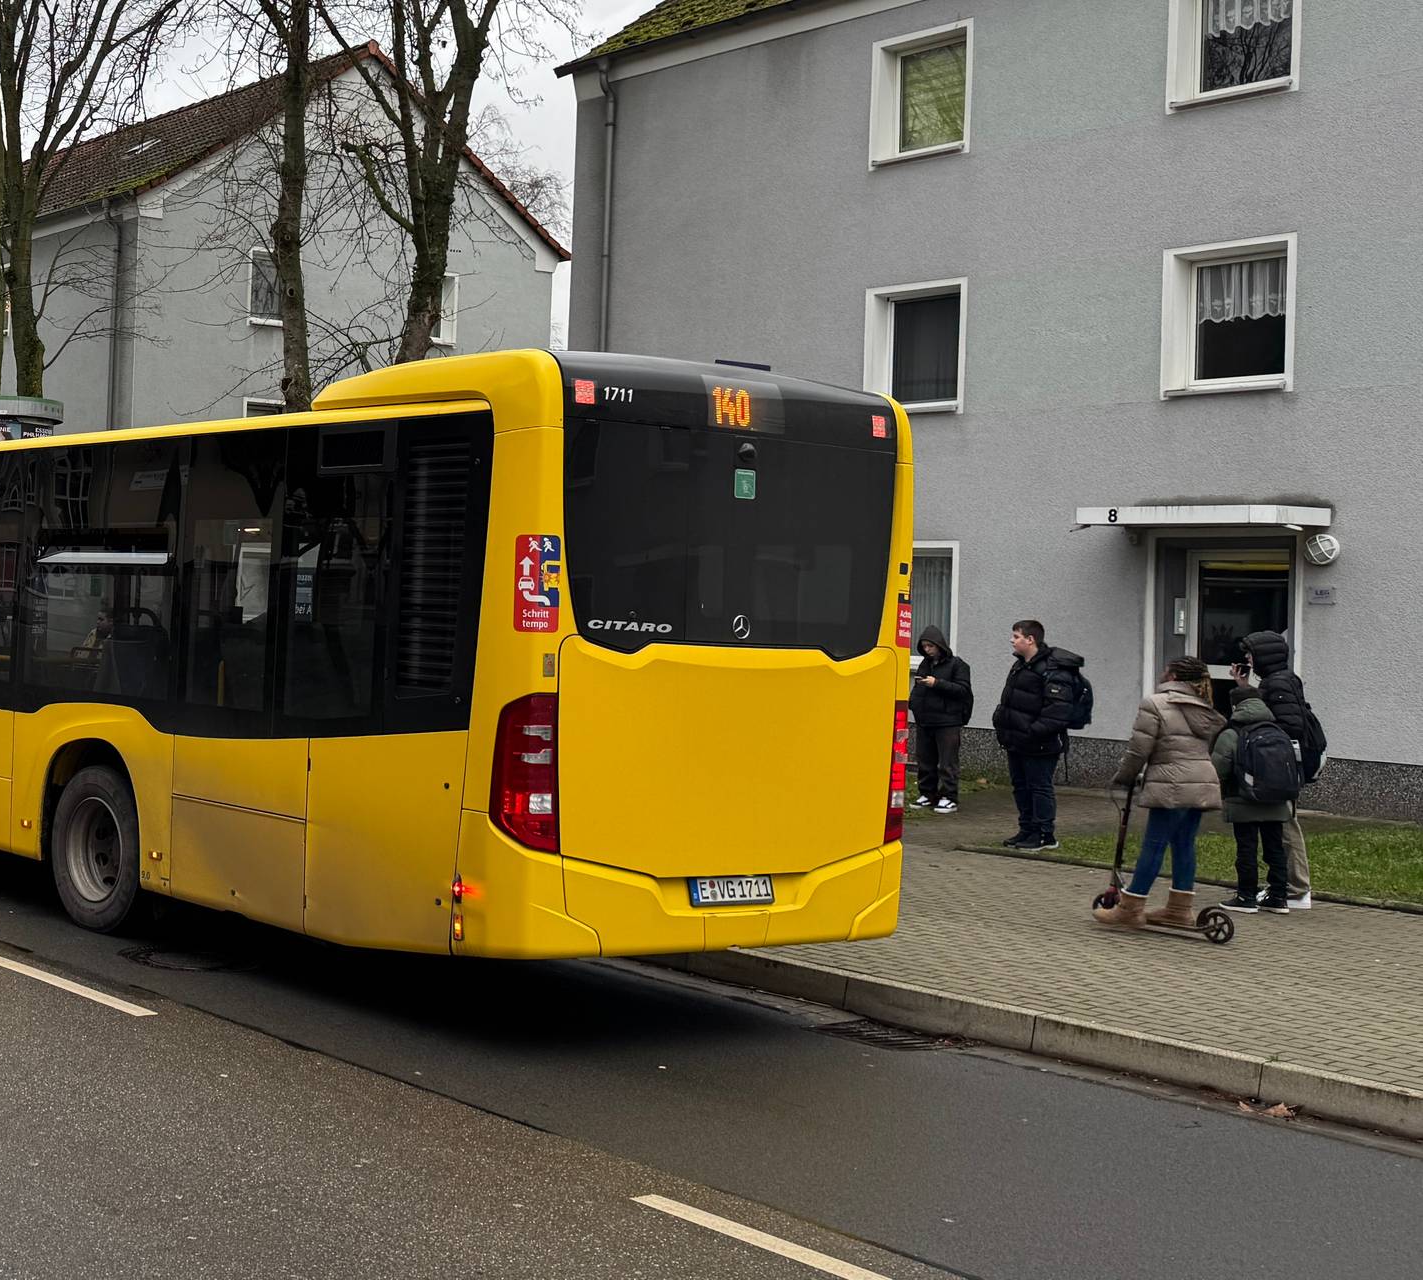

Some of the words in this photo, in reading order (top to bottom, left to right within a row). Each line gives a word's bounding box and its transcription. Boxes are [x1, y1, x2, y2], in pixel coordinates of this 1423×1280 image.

[603, 386, 634, 403] 1711
[712, 385, 752, 427] 140
[1108, 508, 1118, 523] 8
[522, 608, 549, 619] Schritt
[522, 619, 549, 630] tempo
[587, 619, 673, 634] CITARO
[699, 881, 710, 900] E
